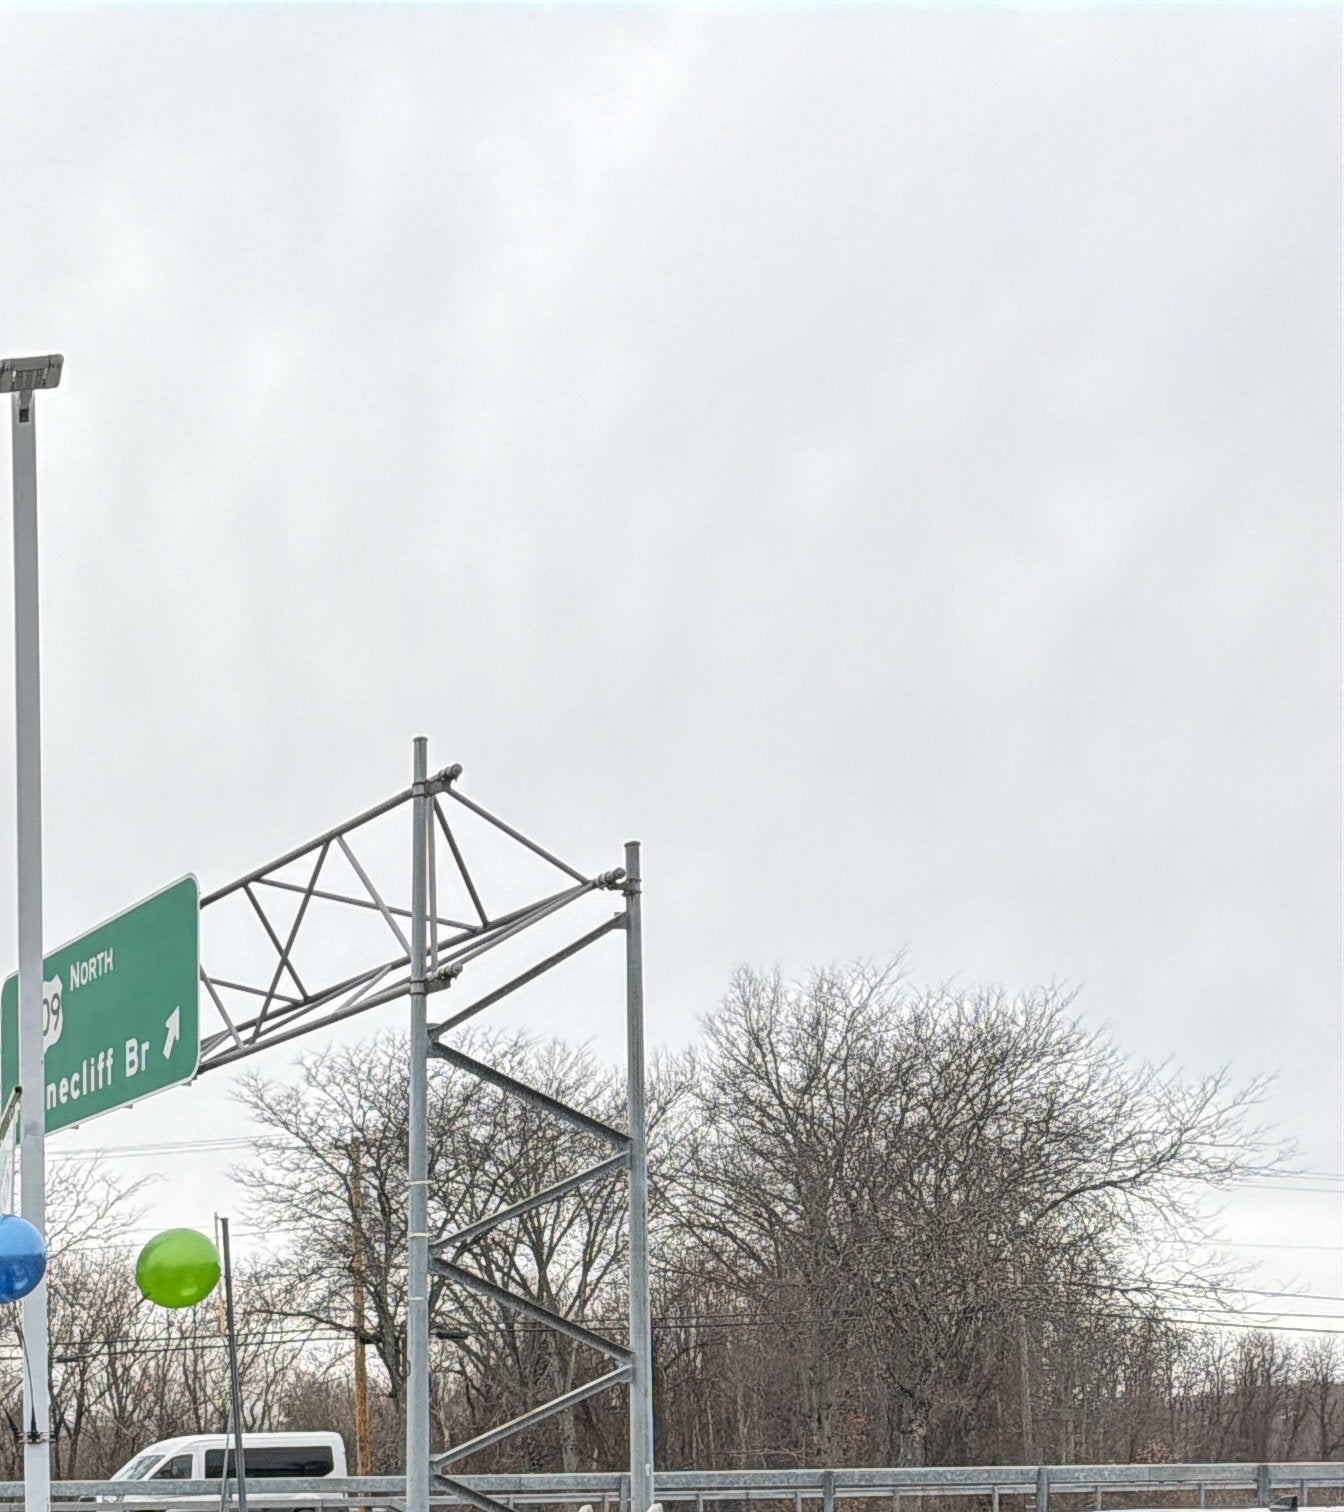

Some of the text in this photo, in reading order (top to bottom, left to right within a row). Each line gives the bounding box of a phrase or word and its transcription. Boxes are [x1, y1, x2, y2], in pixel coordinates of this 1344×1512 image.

[69, 947, 114, 991] NORTH
[43, 992, 61, 1036] 09
[46, 1038, 150, 1110] necliff Br
